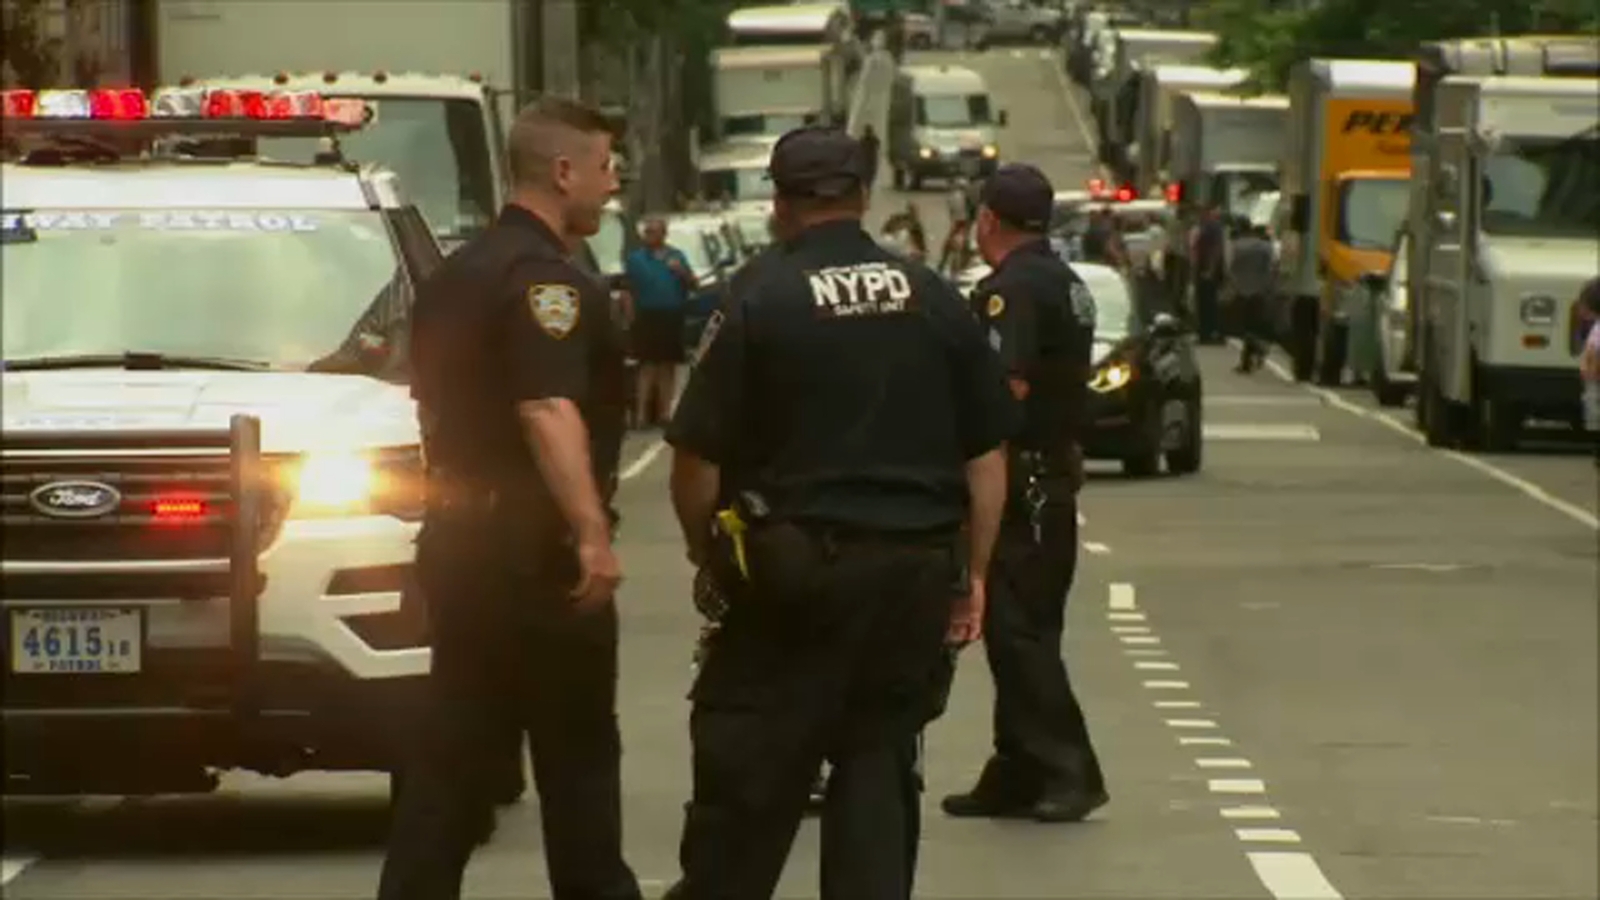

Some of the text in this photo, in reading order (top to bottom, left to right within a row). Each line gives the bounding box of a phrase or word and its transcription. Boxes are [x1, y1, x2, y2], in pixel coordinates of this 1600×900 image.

[138, 212, 317, 232] PATROL
[809, 268, 911, 306] NYPD
[48, 488, 102, 506] Ford
[23, 626, 103, 656] 4615
